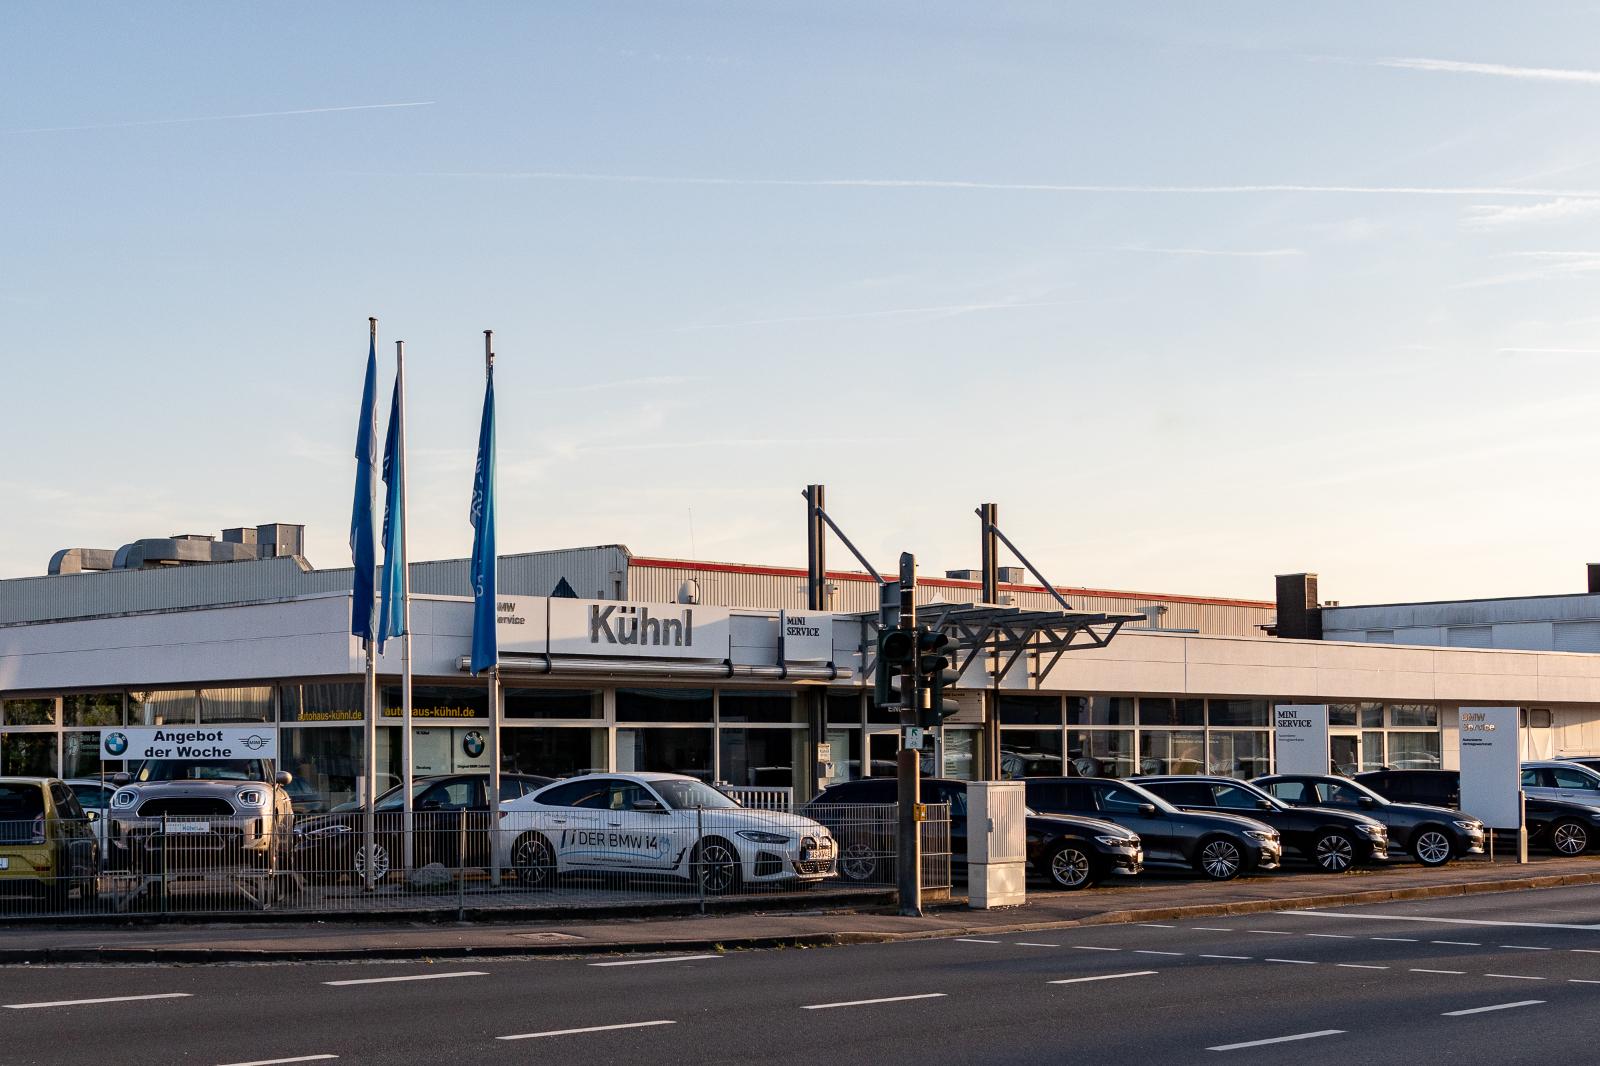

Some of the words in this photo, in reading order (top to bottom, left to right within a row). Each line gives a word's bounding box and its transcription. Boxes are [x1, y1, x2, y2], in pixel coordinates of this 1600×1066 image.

[497, 602, 516, 612] MW
[497, 614, 526, 625] ervice
[787, 616, 806, 626] MINI
[589, 604, 693, 647] Kühnl
[787, 626, 820, 637] SERVICE
[297, 709, 362, 721] autohaus-kühnl.de
[384, 705, 475, 718] autaus-kühnl.de
[1277, 710, 1297, 719] MINI
[1277, 719, 1312, 728] SERVICE
[153, 730, 223, 745] Angebot
[144, 746, 172, 758] der
[176, 746, 232, 758] Woche
[579, 831, 605, 847] DER
[609, 833, 642, 849] BMW
[645, 835, 658, 850] i4
